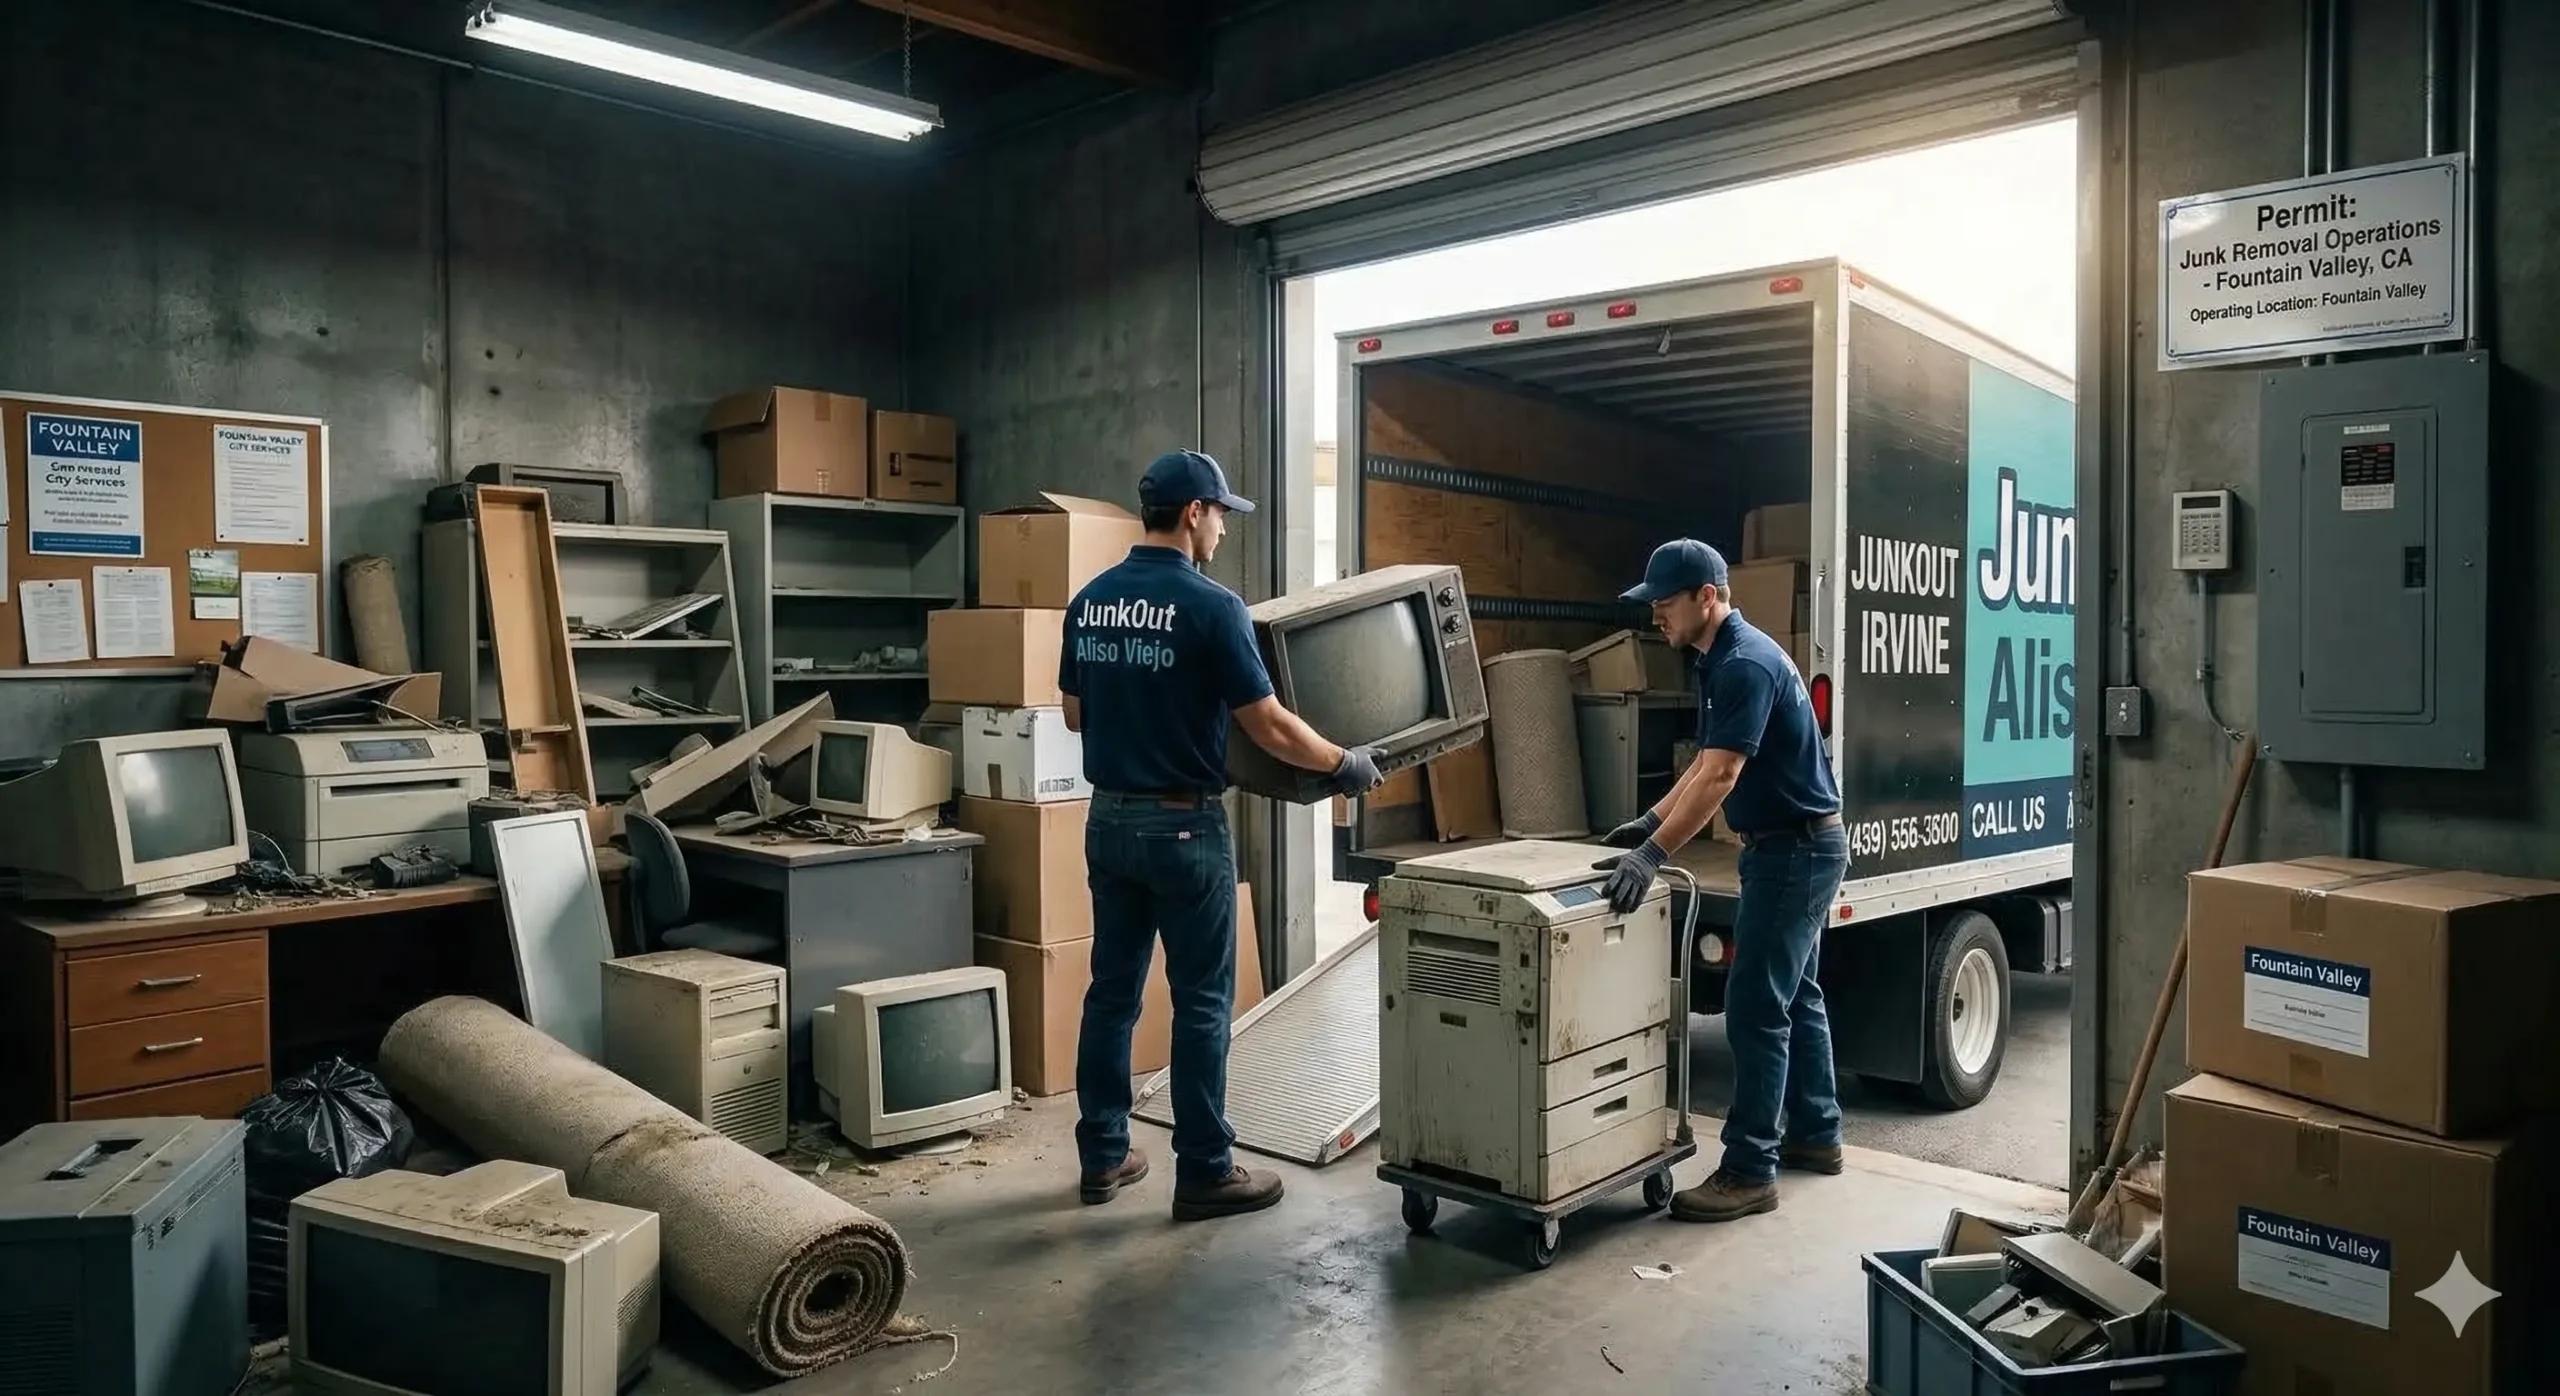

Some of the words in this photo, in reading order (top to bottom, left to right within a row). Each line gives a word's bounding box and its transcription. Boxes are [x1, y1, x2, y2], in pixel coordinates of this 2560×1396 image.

[2257, 194, 2356, 231] Permit:
[2180, 246, 2226, 269] Junk
[2233, 232, 2319, 262] Removal
[2325, 218, 2441, 250] Operations
[2217, 263, 2302, 291] Fountain
[2309, 255, 2374, 279] Valley,
[2381, 247, 2413, 269] CA
[2190, 303, 2253, 325] Operating
[2257, 296, 2318, 315] Location:
[2322, 289, 2381, 307] Fountain
[2385, 283, 2427, 300] Valley
[39, 422, 131, 441] FOUNTAIN
[52, 439, 120, 456] VALLEY
[75, 475, 126, 488] Services
[1978, 467, 2075, 614] Jun
[1851, 535, 1960, 599] JUNKOUT
[1077, 598, 1176, 632] JunkOut
[1076, 636, 1118, 662] Aliso
[1124, 637, 1175, 672] Viejo
[1861, 610, 1950, 674] IRVINE
[1983, 636, 2075, 742] Alis
[1972, 800, 2017, 838] CALL
[2023, 795, 2045, 831] US
[2251, 953, 2313, 979] Fountain
[2316, 965, 2362, 992] Valley
[2247, 1214, 2321, 1247] Fountain
[2326, 1233, 2380, 1264] Valley
